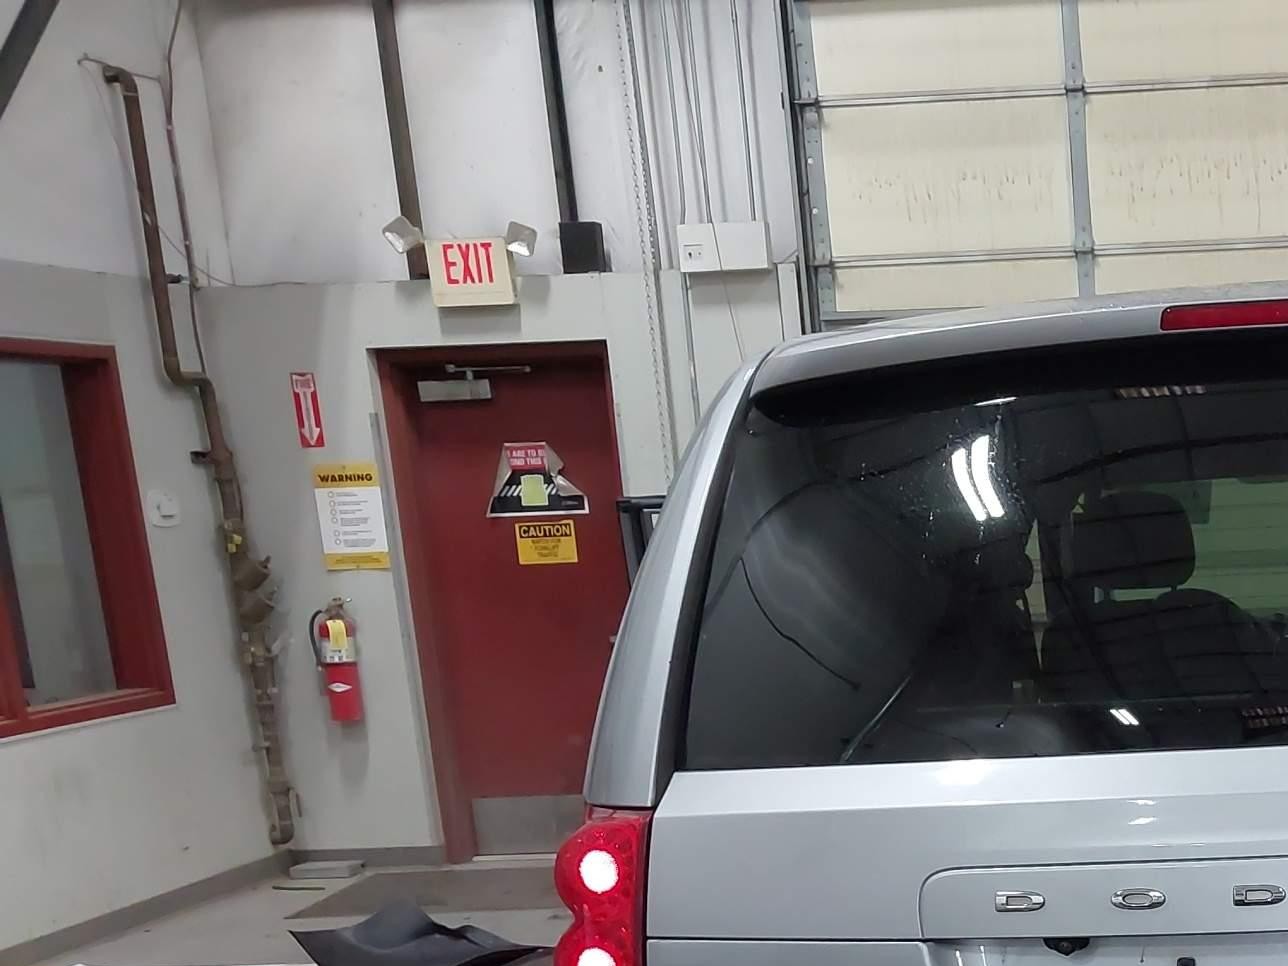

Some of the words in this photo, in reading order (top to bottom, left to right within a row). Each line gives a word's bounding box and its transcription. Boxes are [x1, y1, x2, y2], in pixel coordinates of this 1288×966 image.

[441, 242, 494, 285] EXIT
[318, 473, 373, 483] WARNING
[520, 524, 570, 537] CAUTION
